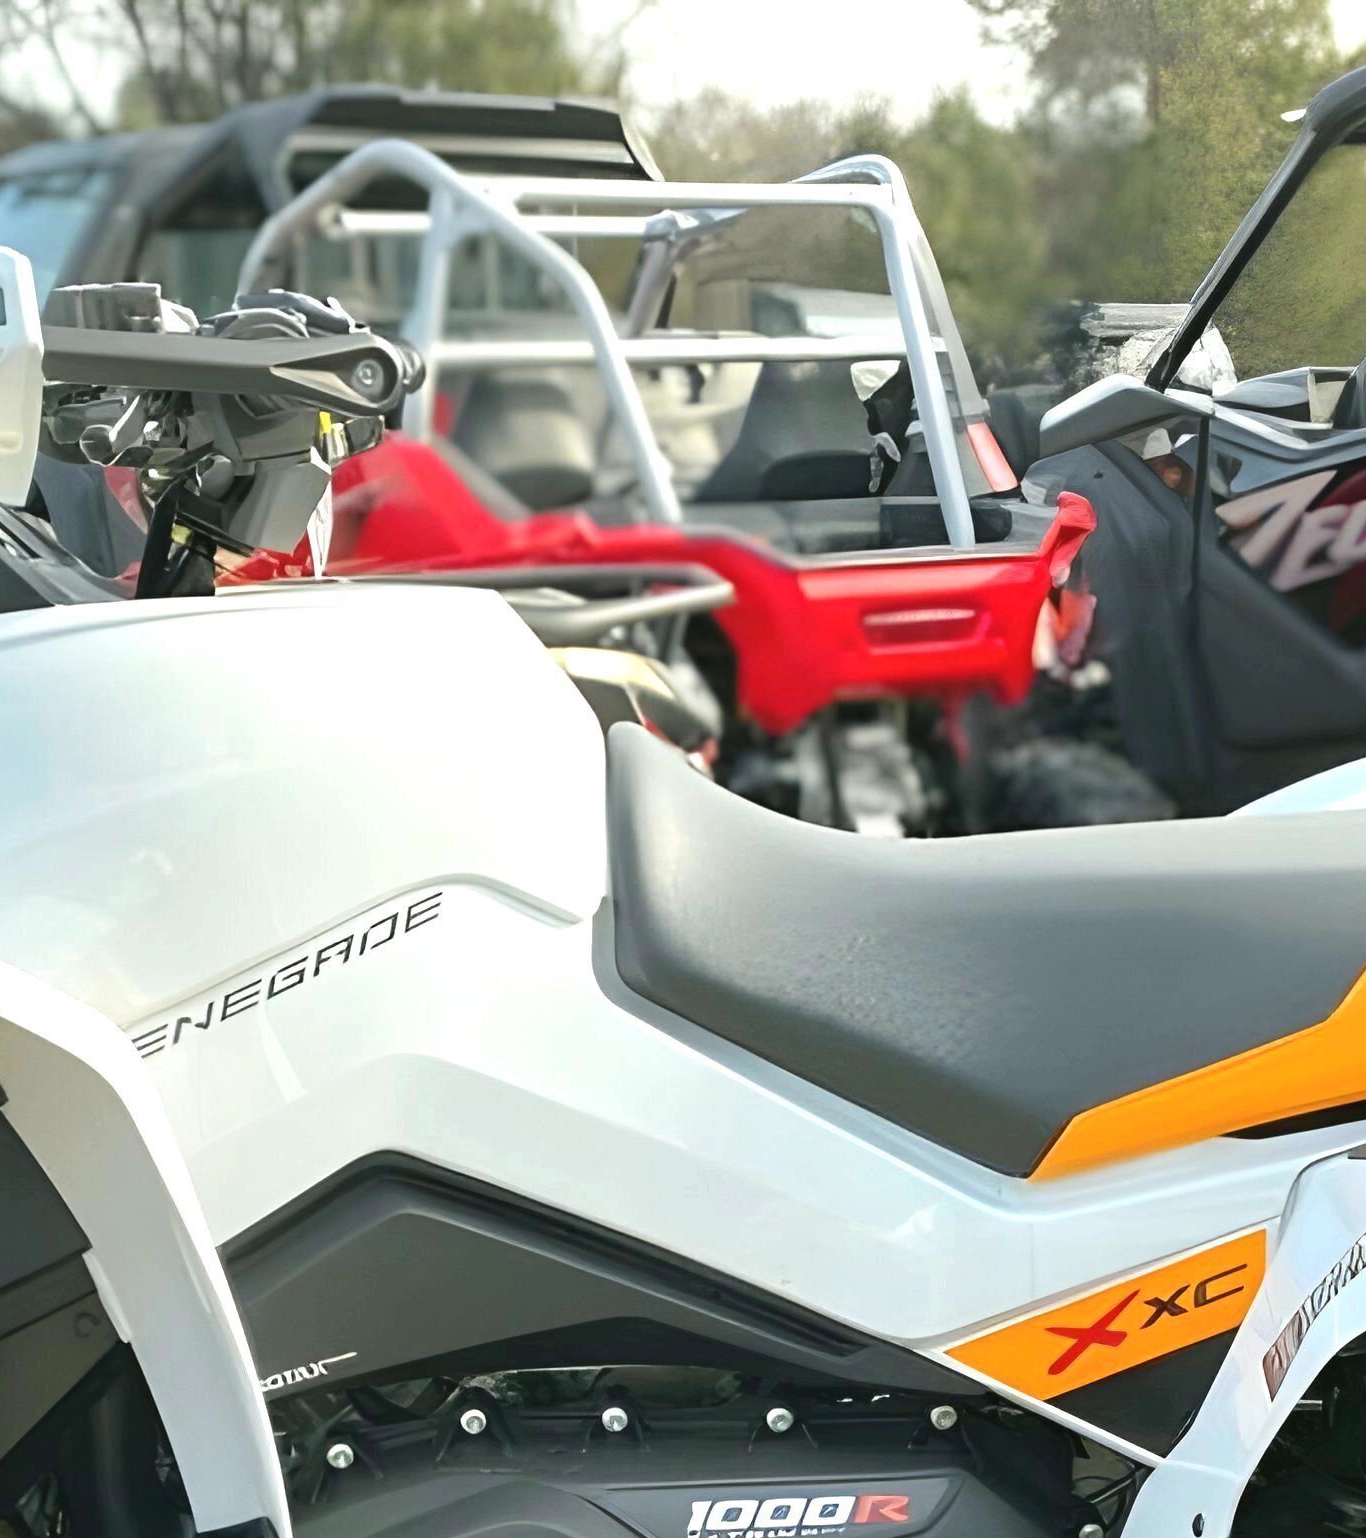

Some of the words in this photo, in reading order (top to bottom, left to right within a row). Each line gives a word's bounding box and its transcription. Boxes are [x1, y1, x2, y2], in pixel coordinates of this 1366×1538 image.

[131, 891, 444, 1059] ENEGADE
[1042, 1287, 1141, 1376] X
[687, 1495, 910, 1535] 1000R
